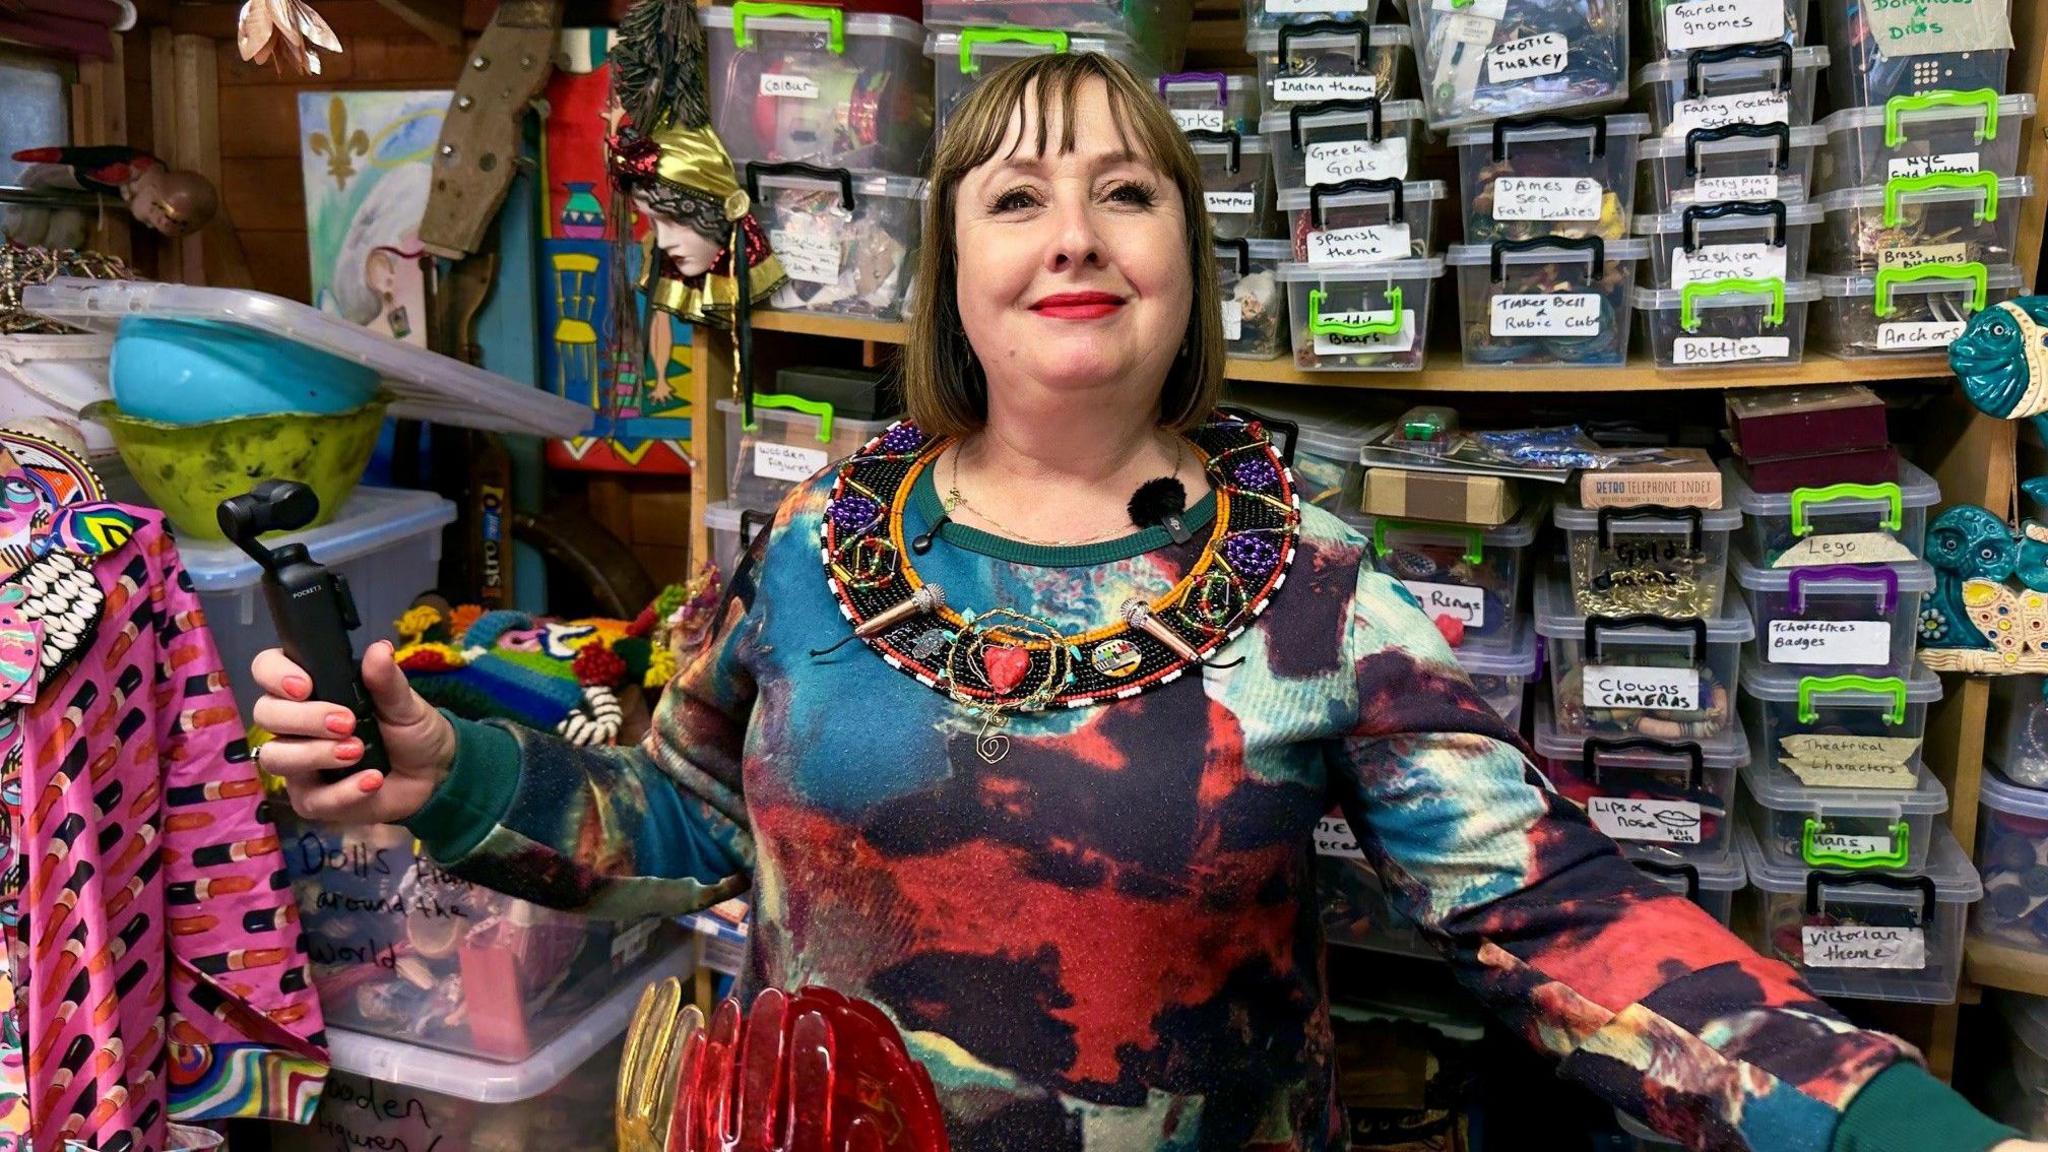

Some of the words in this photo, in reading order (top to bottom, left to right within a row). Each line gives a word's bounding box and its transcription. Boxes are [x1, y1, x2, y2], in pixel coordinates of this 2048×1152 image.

[1675, 3, 1736, 18] Garden
[1683, 16, 1753, 34] gnomes
[1494, 53, 1562, 71] TURKEY
[1280, 80, 1325, 93] Indian
[1328, 80, 1373, 94] theme
[1683, 103, 1728, 116] Fancy
[1311, 144, 1366, 160] Greek
[1326, 161, 1376, 176] Gods
[1498, 206, 1527, 216] Fat
[1326, 244, 1381, 258] theme
[1685, 251, 1762, 264] Fashion
[1884, 250, 1923, 263] Brass
[1688, 269, 1754, 280] Icons
[1505, 316, 1552, 330] Rubic
[1884, 327, 1960, 345] Anchors
[1684, 342, 1761, 360] Bottles
[1596, 481, 1625, 494] RETRO
[1627, 480, 1678, 494] TELEPHONE
[1681, 481, 1712, 494] INDEX
[1808, 539, 1856, 557] Lego
[1431, 590, 1480, 621] Rings
[1774, 637, 1826, 650] Badges
[1598, 679, 1679, 695] Clowns
[1602, 693, 1690, 709] CAMERAS
[1803, 739, 1886, 752] Theatrical
[298, 831, 391, 878] Dolls
[316, 891, 408, 917] around
[415, 895, 469, 919] the
[1822, 944, 1891, 961] theme
[328, 1079, 431, 1129] ooden
